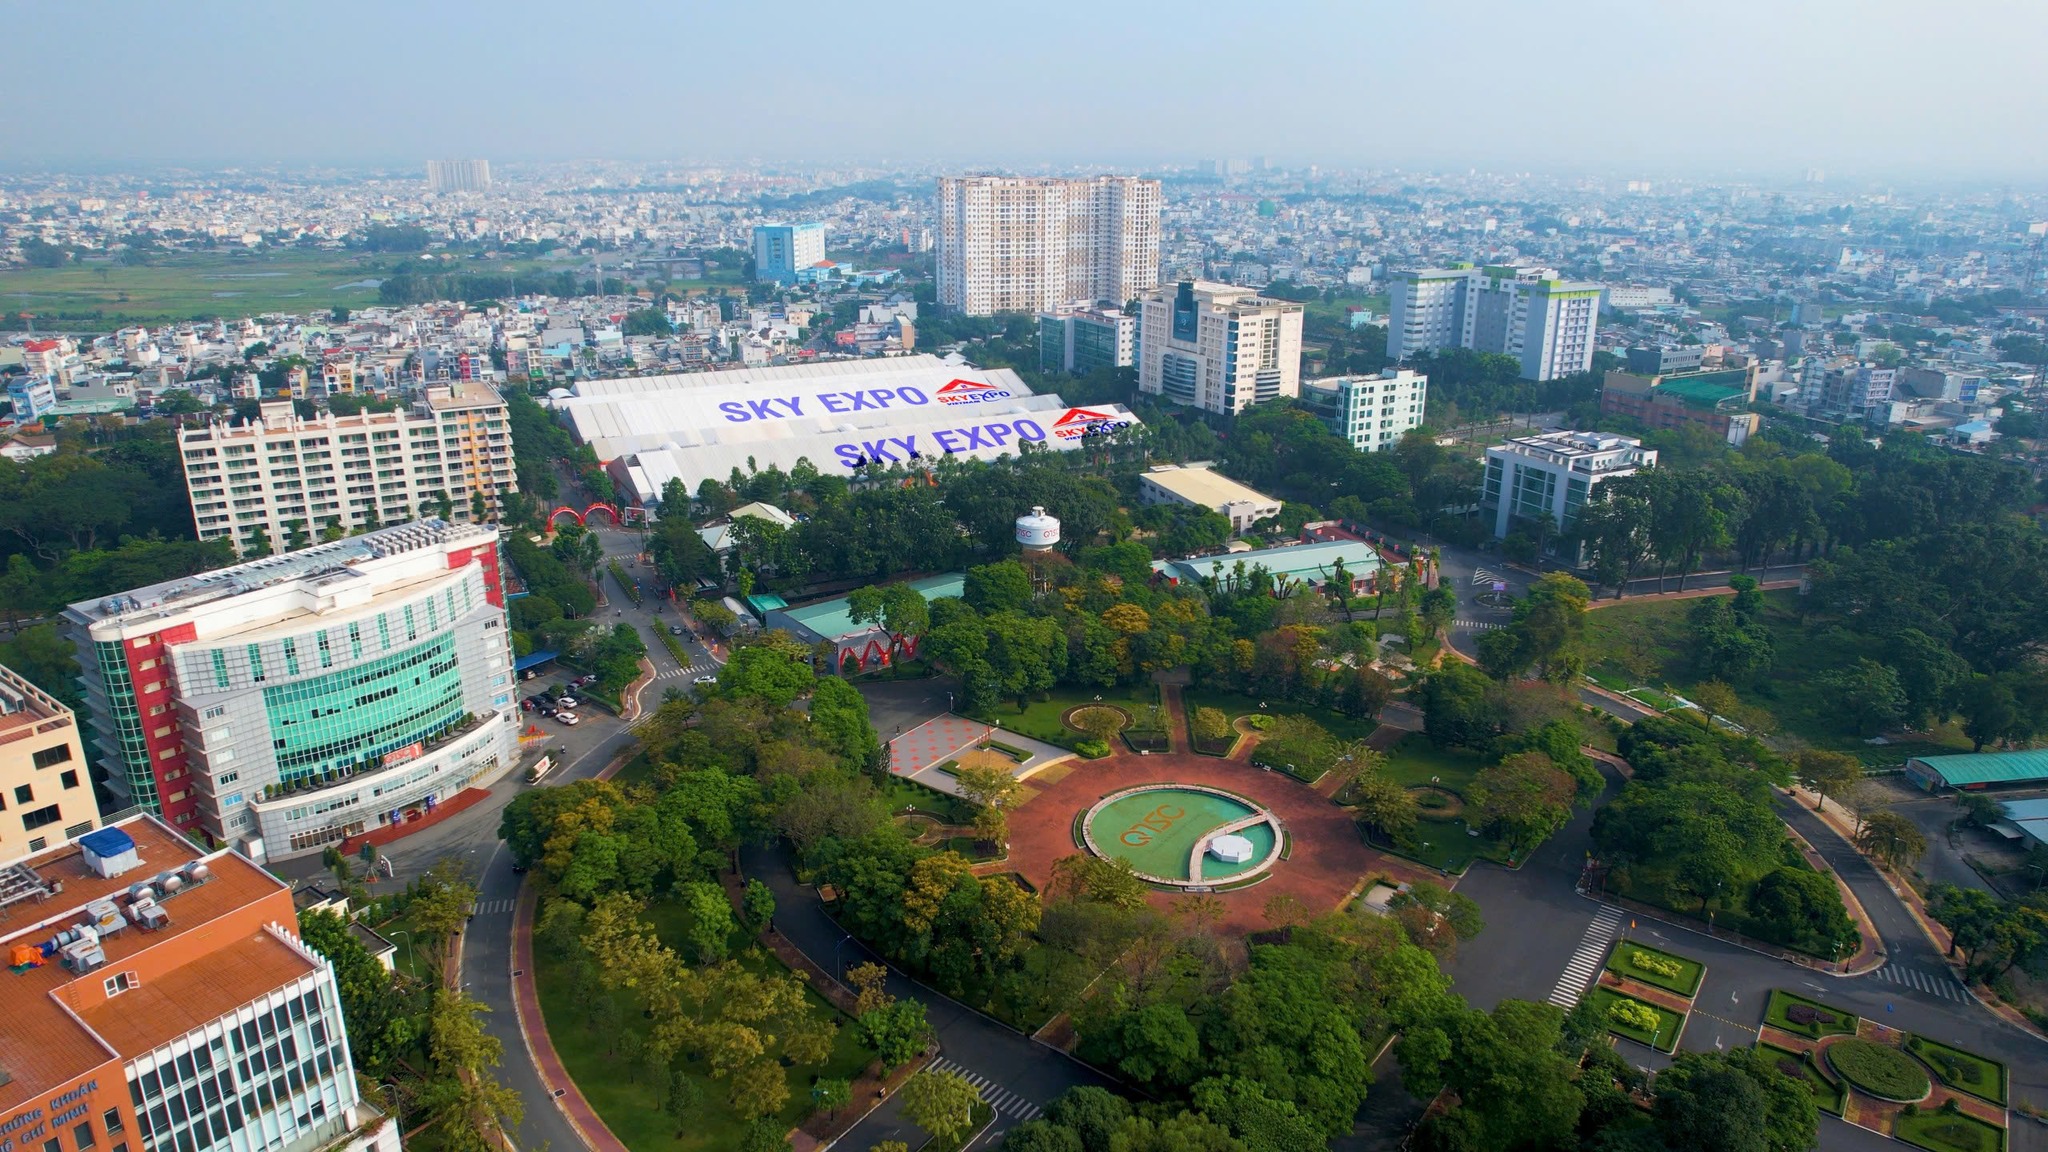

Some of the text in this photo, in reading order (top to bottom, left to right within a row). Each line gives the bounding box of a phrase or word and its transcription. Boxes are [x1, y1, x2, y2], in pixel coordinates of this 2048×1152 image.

[719, 387, 929, 422] SKY EXPO
[834, 419, 1046, 468] SKY EXPO
[1120, 803, 1185, 847] QTSC
[52, 1102, 88, 1128] MINH
